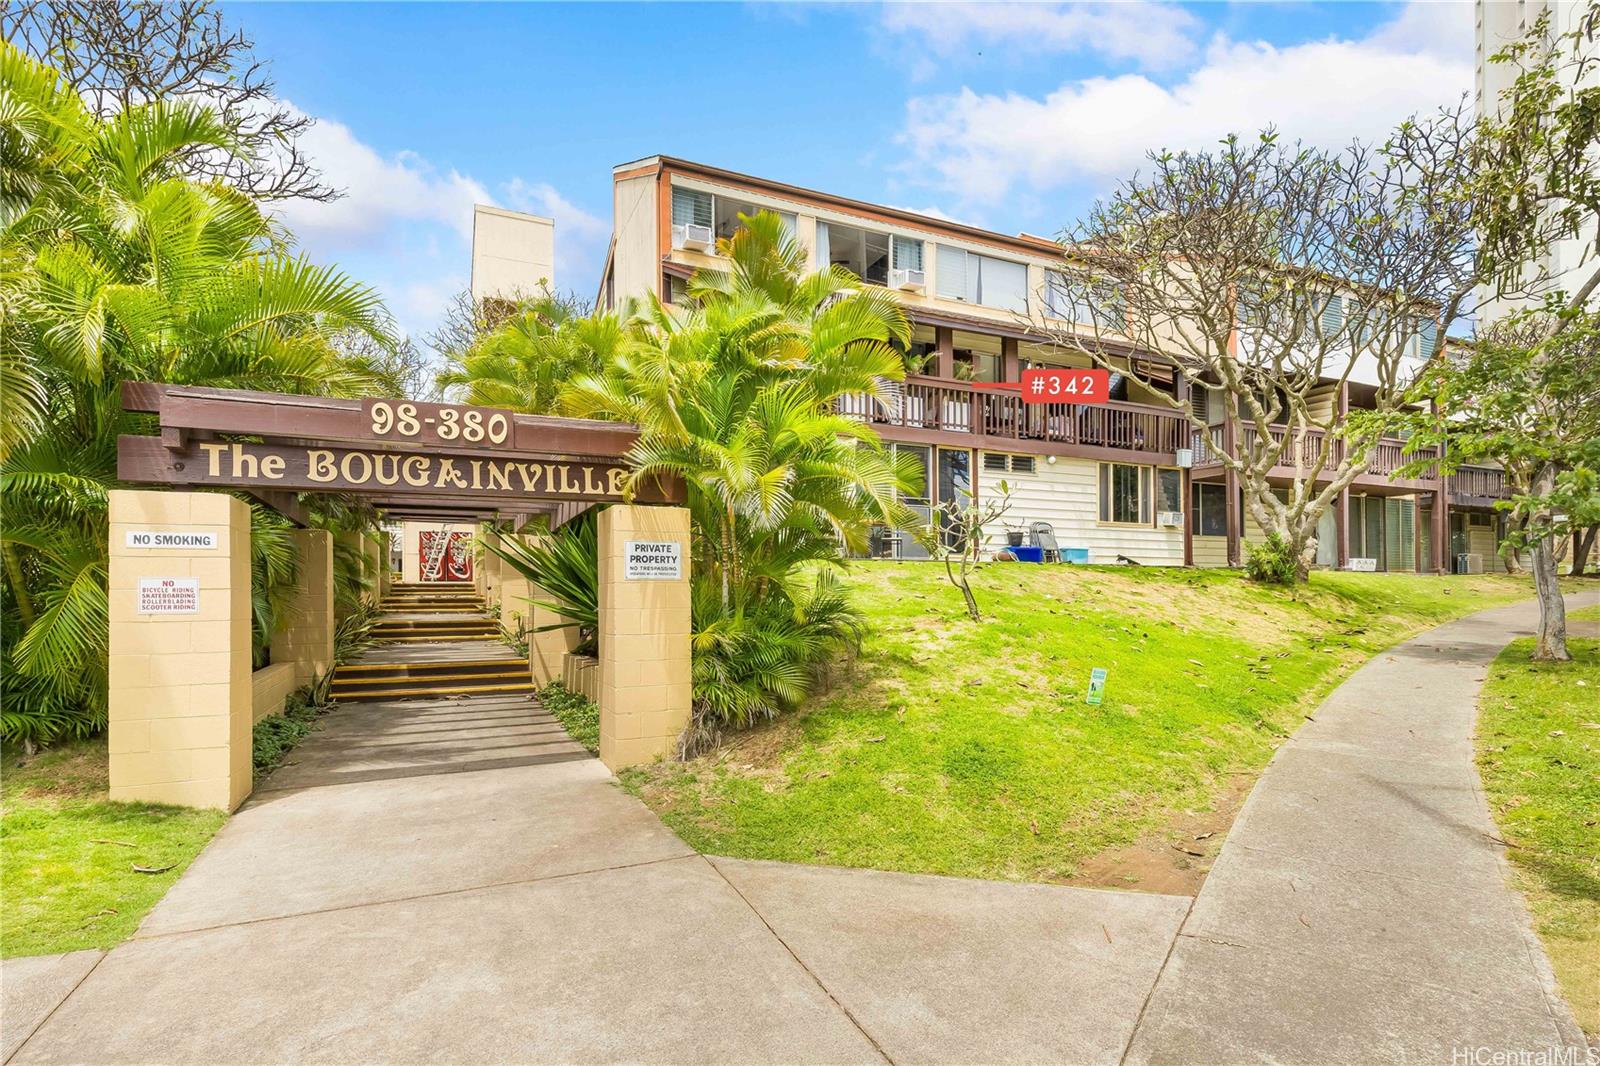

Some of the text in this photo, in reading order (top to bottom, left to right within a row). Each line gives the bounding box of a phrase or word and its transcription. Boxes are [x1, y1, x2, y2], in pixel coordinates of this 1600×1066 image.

[371, 402, 508, 444] 98-380
[200, 443, 286, 479] The
[133, 534, 211, 546] NO SMOKING
[634, 544, 672, 553] PRIVATE
[630, 555, 677, 564] PROPERTY
